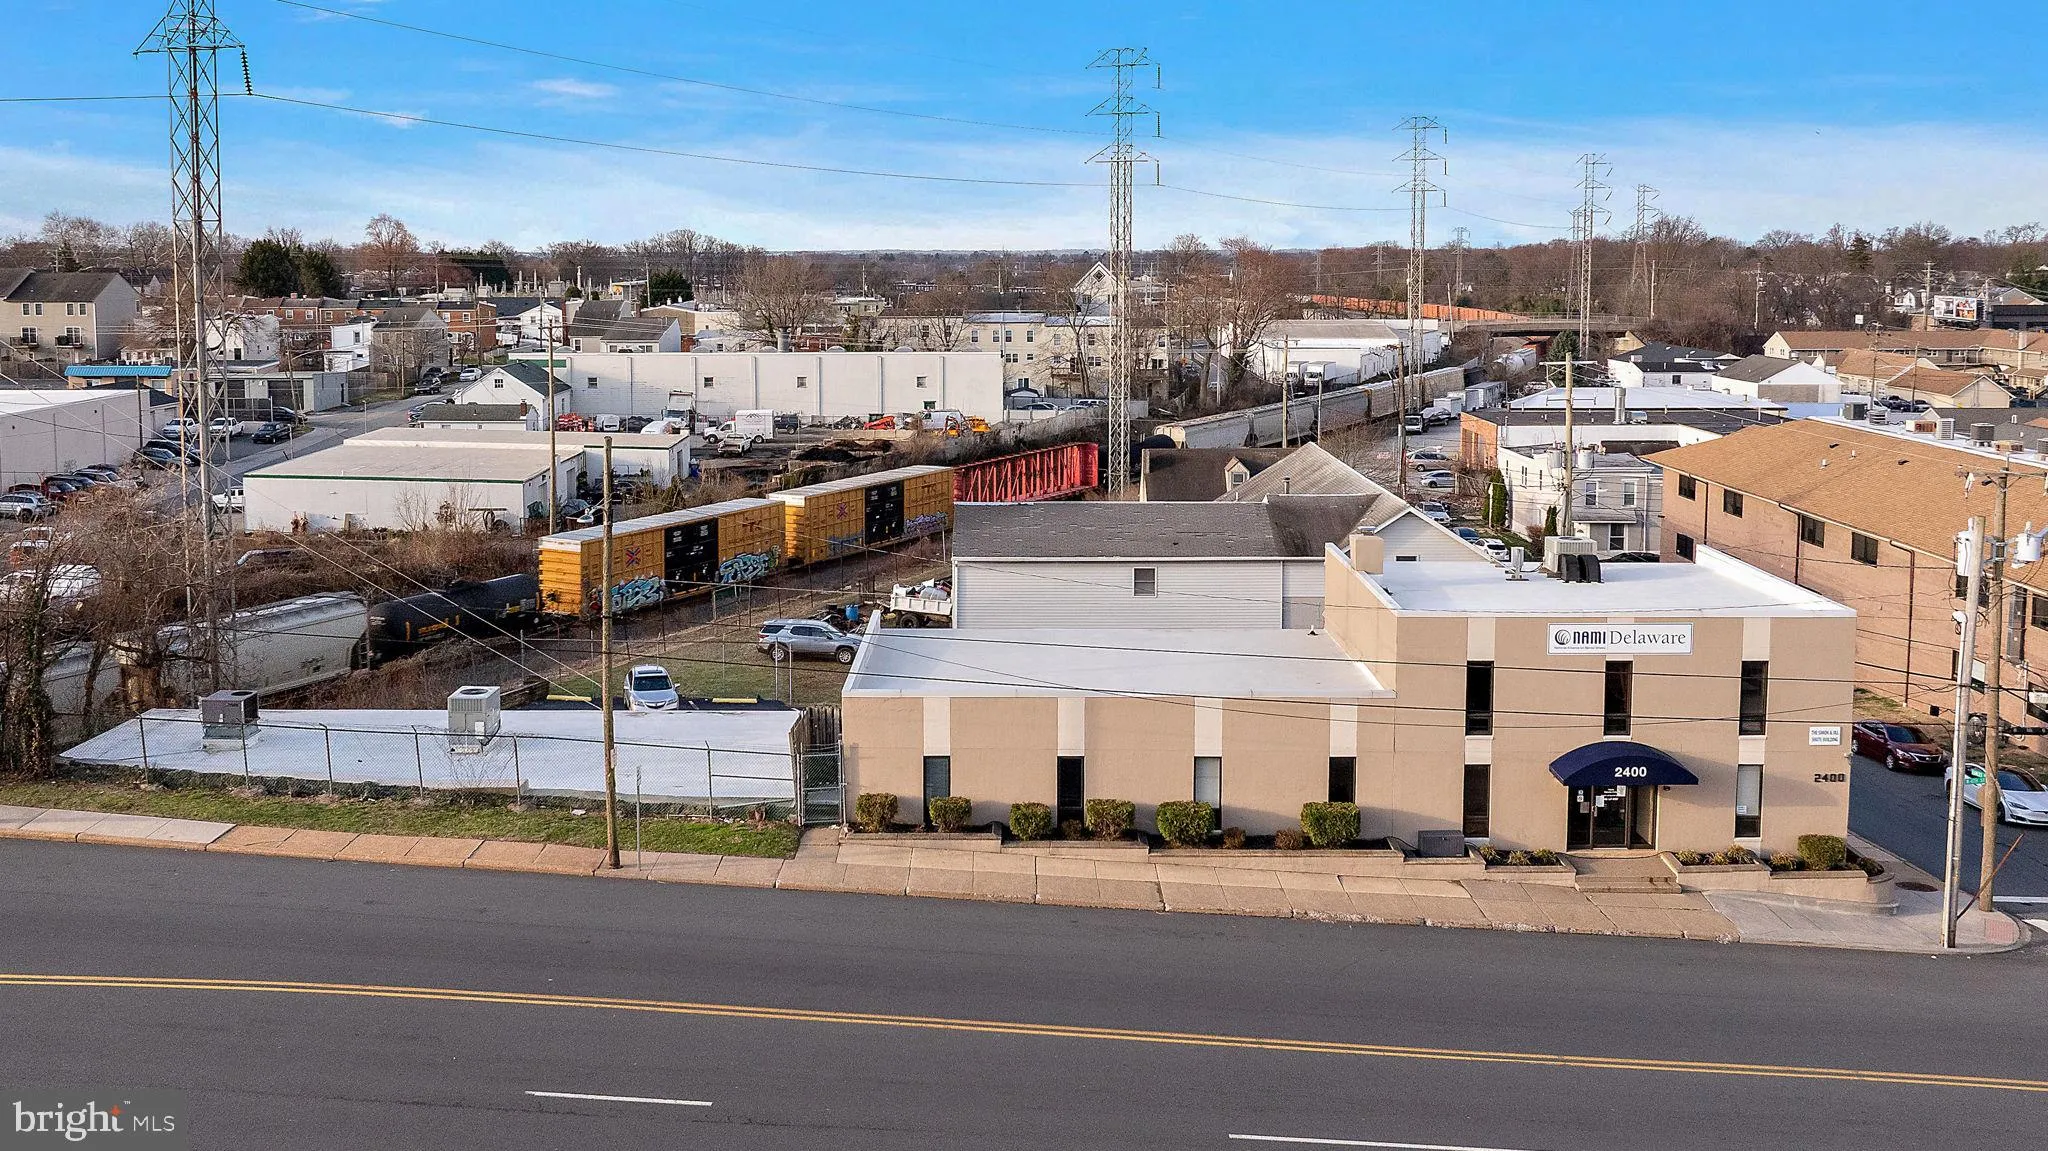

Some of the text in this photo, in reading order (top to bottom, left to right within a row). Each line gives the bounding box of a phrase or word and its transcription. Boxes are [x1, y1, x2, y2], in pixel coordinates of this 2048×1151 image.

[1573, 630, 1686, 645] NAMI Delaware
[1614, 766, 1648, 778] 2400
[1814, 773, 1845, 783] 2400
